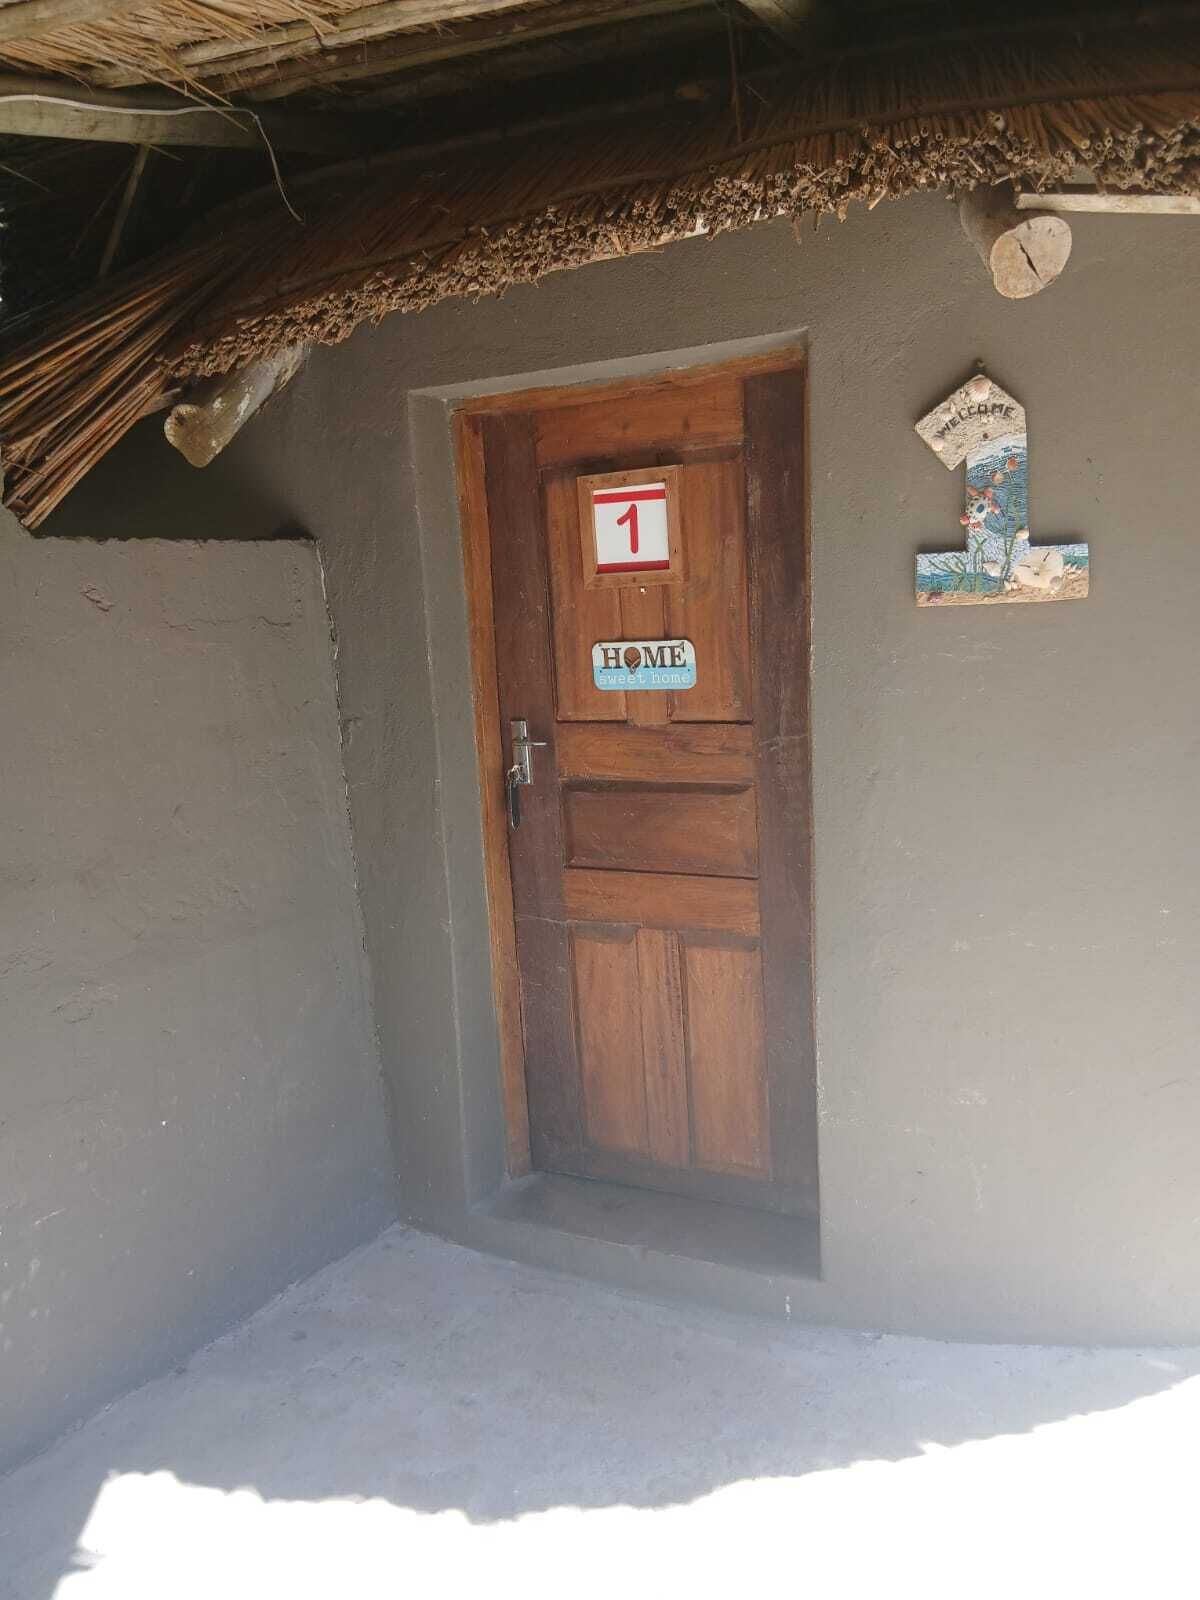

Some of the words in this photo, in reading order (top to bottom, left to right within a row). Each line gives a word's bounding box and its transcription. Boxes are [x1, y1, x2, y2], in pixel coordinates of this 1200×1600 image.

[934, 402, 1016, 440] WELCOME
[616, 503, 639, 554] 1
[601, 642, 687, 671] HOME
[600, 672, 646, 685] sweet
[651, 671, 690, 684] home
